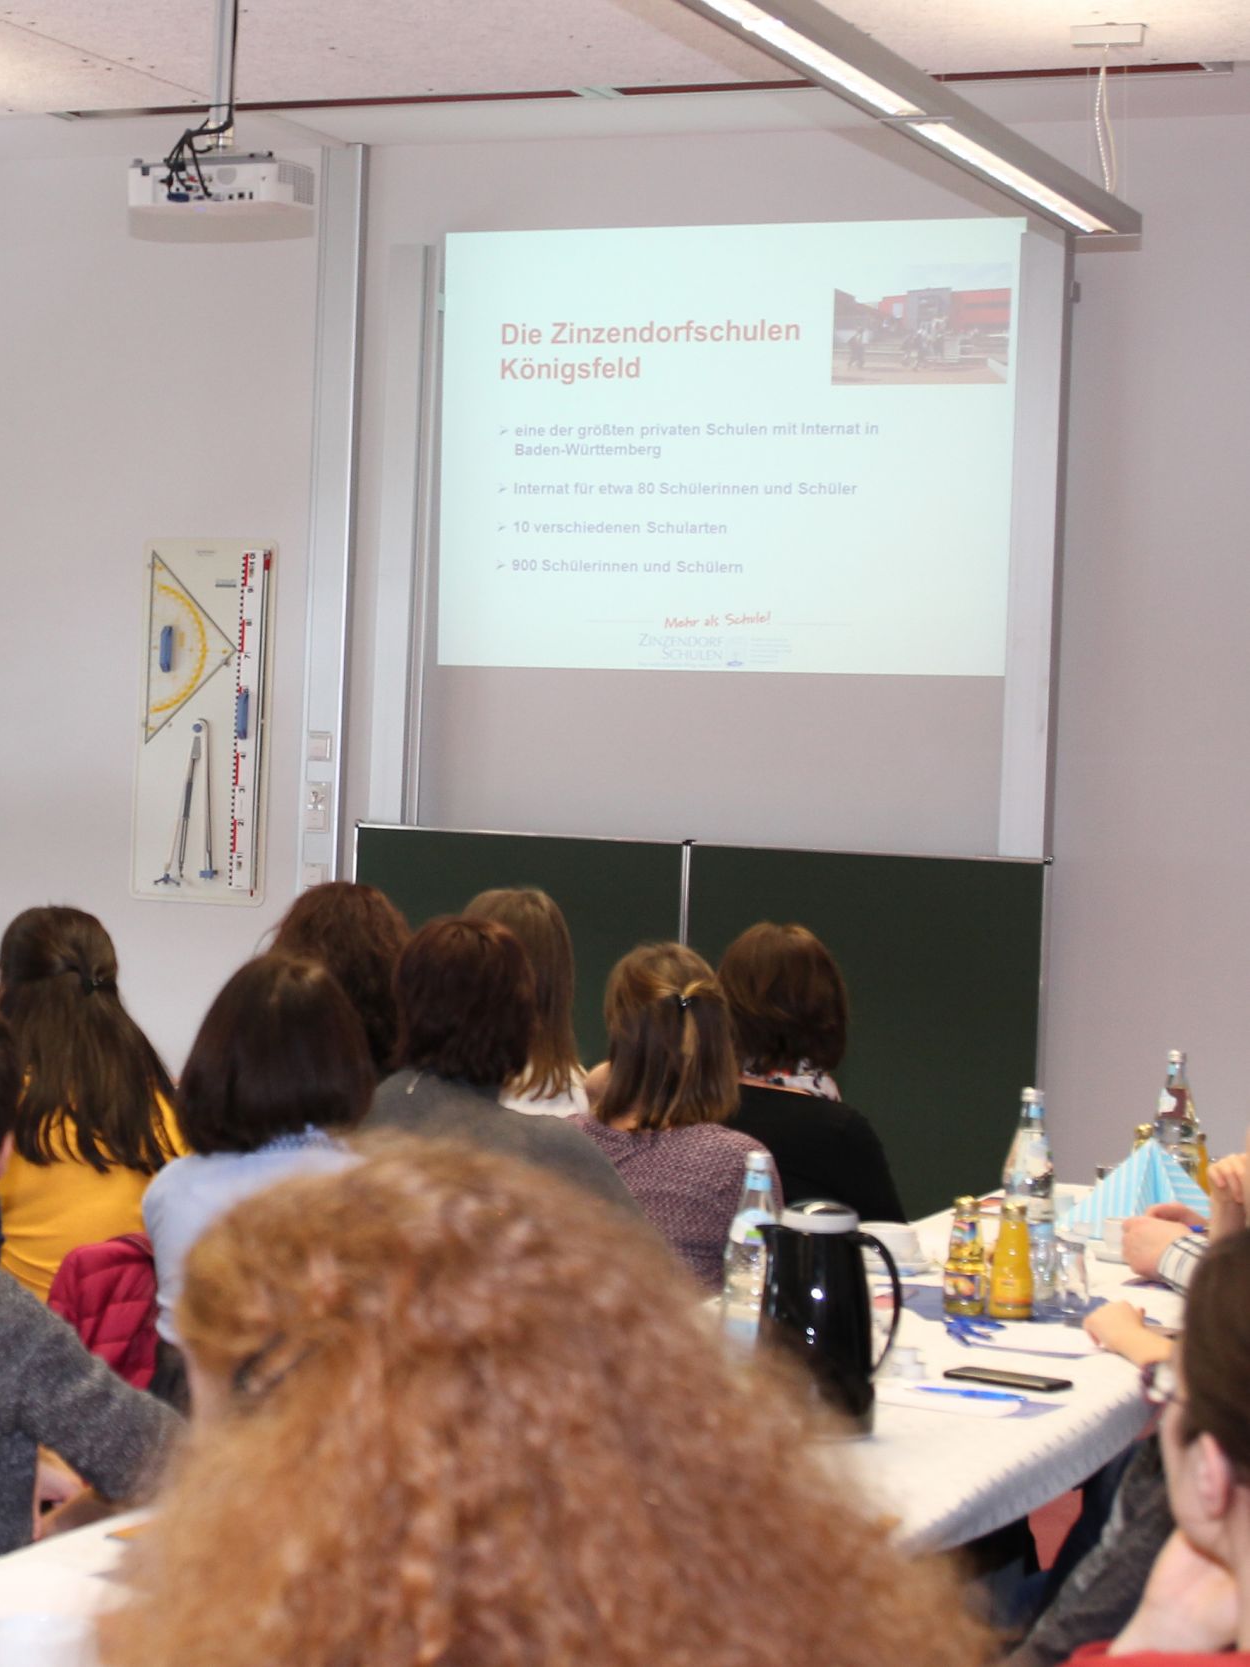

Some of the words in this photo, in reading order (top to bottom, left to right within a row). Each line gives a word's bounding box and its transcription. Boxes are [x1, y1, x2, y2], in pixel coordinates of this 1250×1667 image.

[501, 322, 542, 345] Die
[550, 319, 800, 345] Zinzendorfschulen
[501, 356, 641, 385] Königsfeld
[515, 424, 545, 437] eine
[549, 423, 574, 437] der
[578, 423, 635, 440] größten
[640, 423, 701, 440] privaten
[706, 422, 768, 436] Schulen
[772, 422, 797, 436] mit
[800, 421, 861, 436] Internat
[864, 421, 879, 435] in
[514, 443, 662, 459] Baden-Württemberg
[513, 481, 570, 495] Internat
[574, 482, 595, 495] für
[598, 483, 634, 495] etwa
[638, 482, 656, 495] 80
[659, 481, 759, 495] Schülerinnen
[764, 482, 793, 495] und
[797, 481, 859, 495] Schüler
[513, 520, 531, 534] 10
[534, 520, 641, 535] verschiedenen
[646, 520, 728, 535] Schularten
[511, 558, 538, 572] 900
[541, 559, 639, 574] Schülerinnen
[643, 560, 671, 574] und
[676, 560, 744, 574] Schülern
[664, 616, 699, 629] Mehr
[703, 615, 719, 628] als
[724, 610, 772, 627] Schule!
[637, 633, 724, 647] ZINZENDORF
